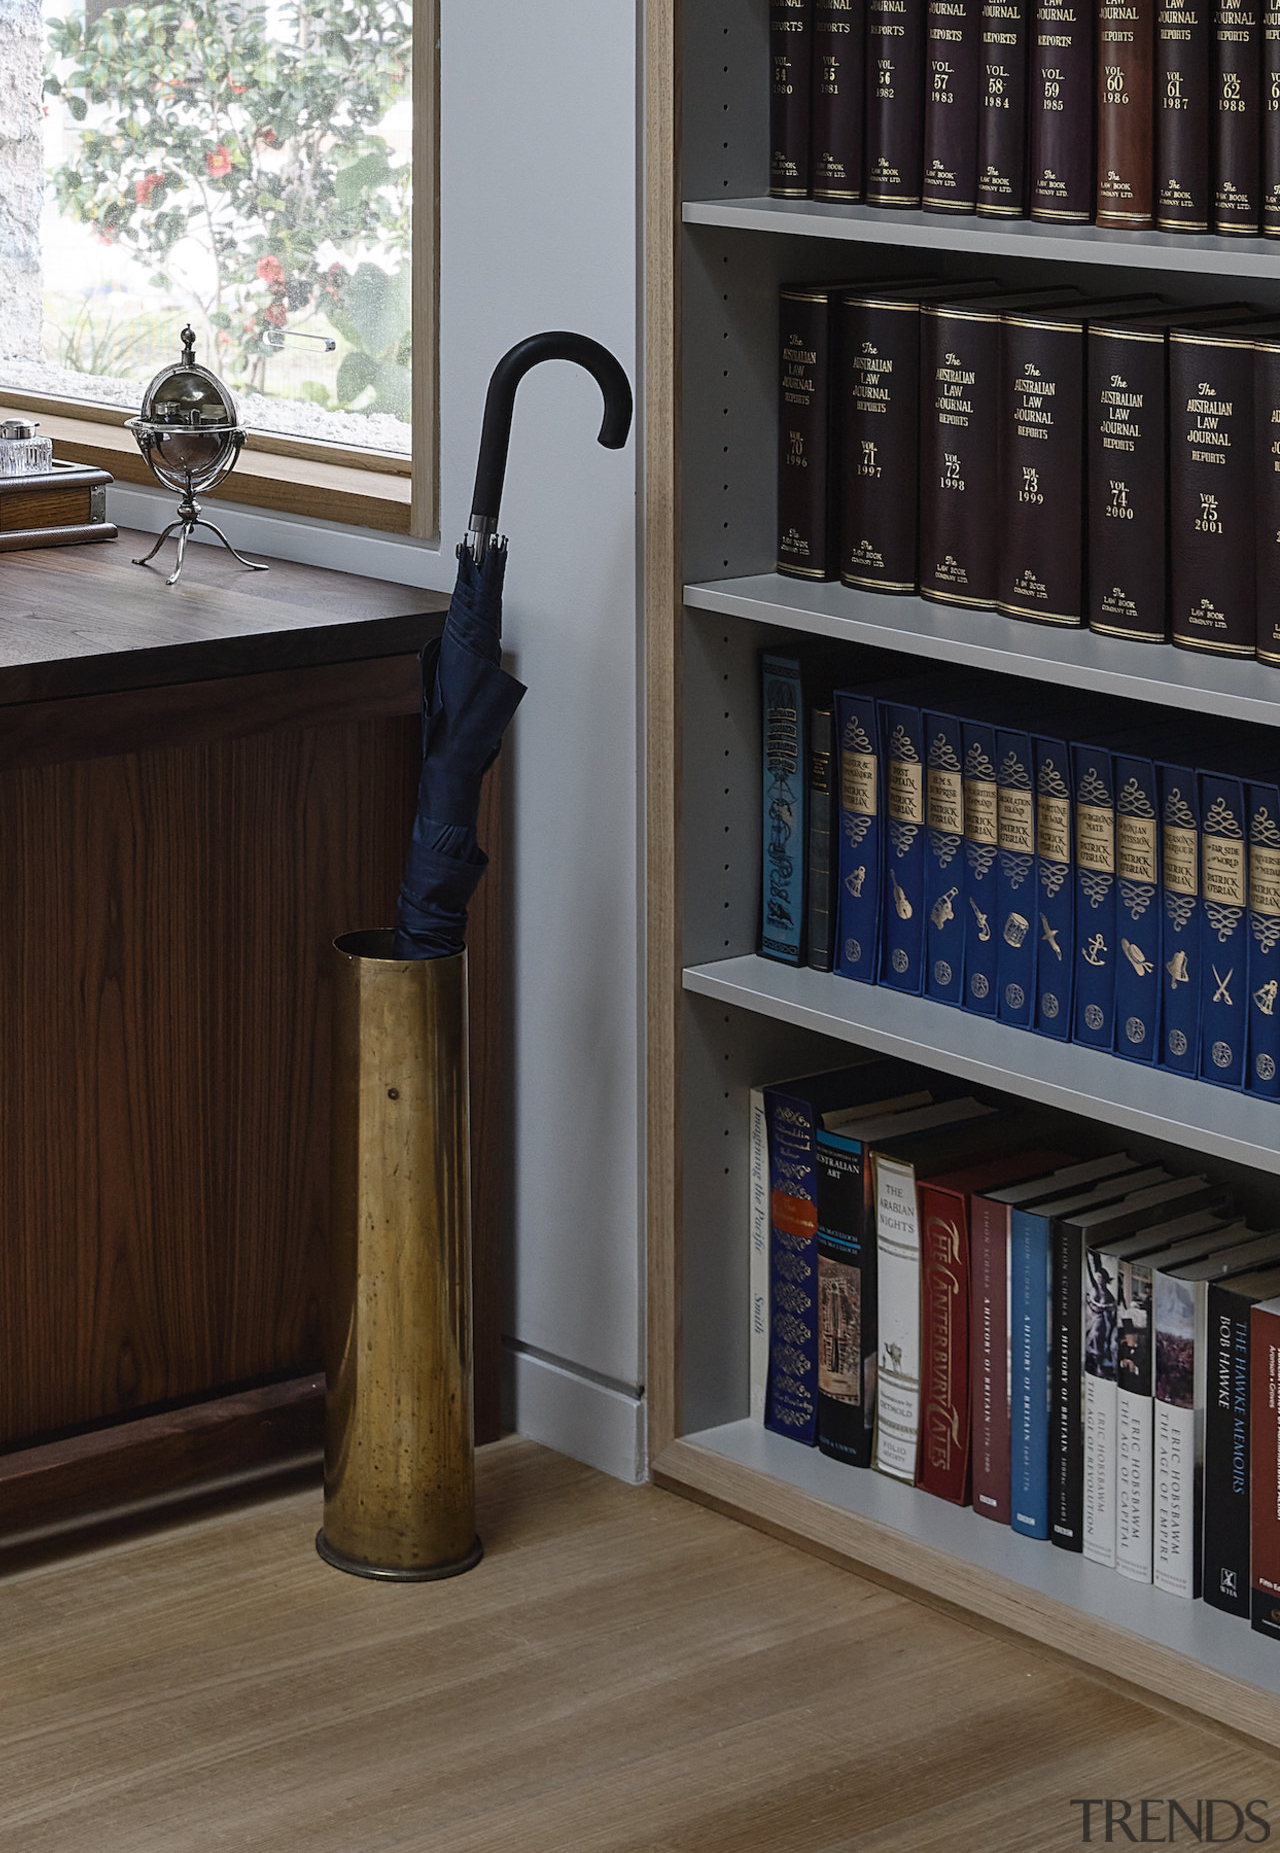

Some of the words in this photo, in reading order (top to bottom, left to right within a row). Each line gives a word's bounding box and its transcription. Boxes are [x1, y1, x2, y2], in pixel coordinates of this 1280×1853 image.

[1158, 11, 1198, 24] JOURNAL
[1160, 29, 1191, 40] REPORTS
[1167, 72, 1183, 81] VOL.
[1167, 81, 1181, 97] 61
[1163, 98, 1188, 109] 1987
[1110, 374, 1128, 388] The
[1198, 382, 1217, 396] The
[1101, 390, 1143, 408] AUSTRALIAN
[1187, 399, 1233, 416] AUSTRALIAN
[1109, 407, 1130, 421] LAW
[1197, 415, 1219, 429] LAW
[1100, 421, 1141, 437] JOURNAL
[1187, 430, 1232, 446] JOURNAL
[1103, 437, 1135, 452] REPORTS
[1191, 450, 1226, 465] REPORTS
[1109, 480, 1129, 492] VOL.
[1111, 491, 1128, 506] 74
[1200, 493, 1218, 505] VOL.
[1106, 506, 1134, 520] 2000
[1201, 503, 1218, 521] 75
[1194, 519, 1223, 534] 2001
[1207, 873, 1239, 888] PATRICK
[753, 1107, 765, 1181] Imagining
[827, 1168, 841, 1180] ART
[755, 1184, 765, 1204] the
[885, 1184, 904, 1199] THE
[880, 1198, 915, 1218] ARABIAN
[754, 1208, 765, 1254] Pacific
[880, 1216, 915, 1234] NIGHTS
[927, 1217, 962, 1265] THE
[754, 1296, 765, 1334] Smith
[1220, 1315, 1231, 1347] BOB
[1235, 1322, 1247, 1353] THE
[1023, 1324, 1031, 1372] HISTORY
[984, 1359, 990, 1372] OF
[1060, 1335, 1068, 1382] HISTORY
[1023, 1376, 1031, 1390] OF
[1219, 1350, 1230, 1409] HAWKE
[1234, 1356, 1246, 1414] HAWKE
[1060, 1388, 1068, 1401] OF
[1023, 1395, 1031, 1441] BRITAIN
[1121, 1400, 1129, 1427] THE
[1060, 1406, 1068, 1452] BRITAIN
[1097, 1411, 1106, 1437] ERIC
[1160, 1413, 1169, 1439] THE
[928, 1403, 962, 1471] TALES
[1087, 1436, 1094, 1450] OF
[1131, 1418, 1140, 1452] ERIC
[883, 1441, 907, 1456] FOLIO
[1121, 1433, 1129, 1459] AGE
[1171, 1428, 1180, 1463] ERIC
[1160, 1447, 1169, 1473] AGE
[1233, 1417, 1245, 1494] MEMOIRS
[1097, 1443, 1106, 1513] HOBSBAWM
[1121, 1467, 1129, 1484] OF
[1131, 1459, 1140, 1539] HOBSBAWM
[1160, 1482, 1169, 1500] OF
[1121, 1491, 1129, 1547] CAPITAL
[1171, 1471, 1180, 1555] HOBSBAWM
[1160, 1509, 1169, 1563] EMPIRE
